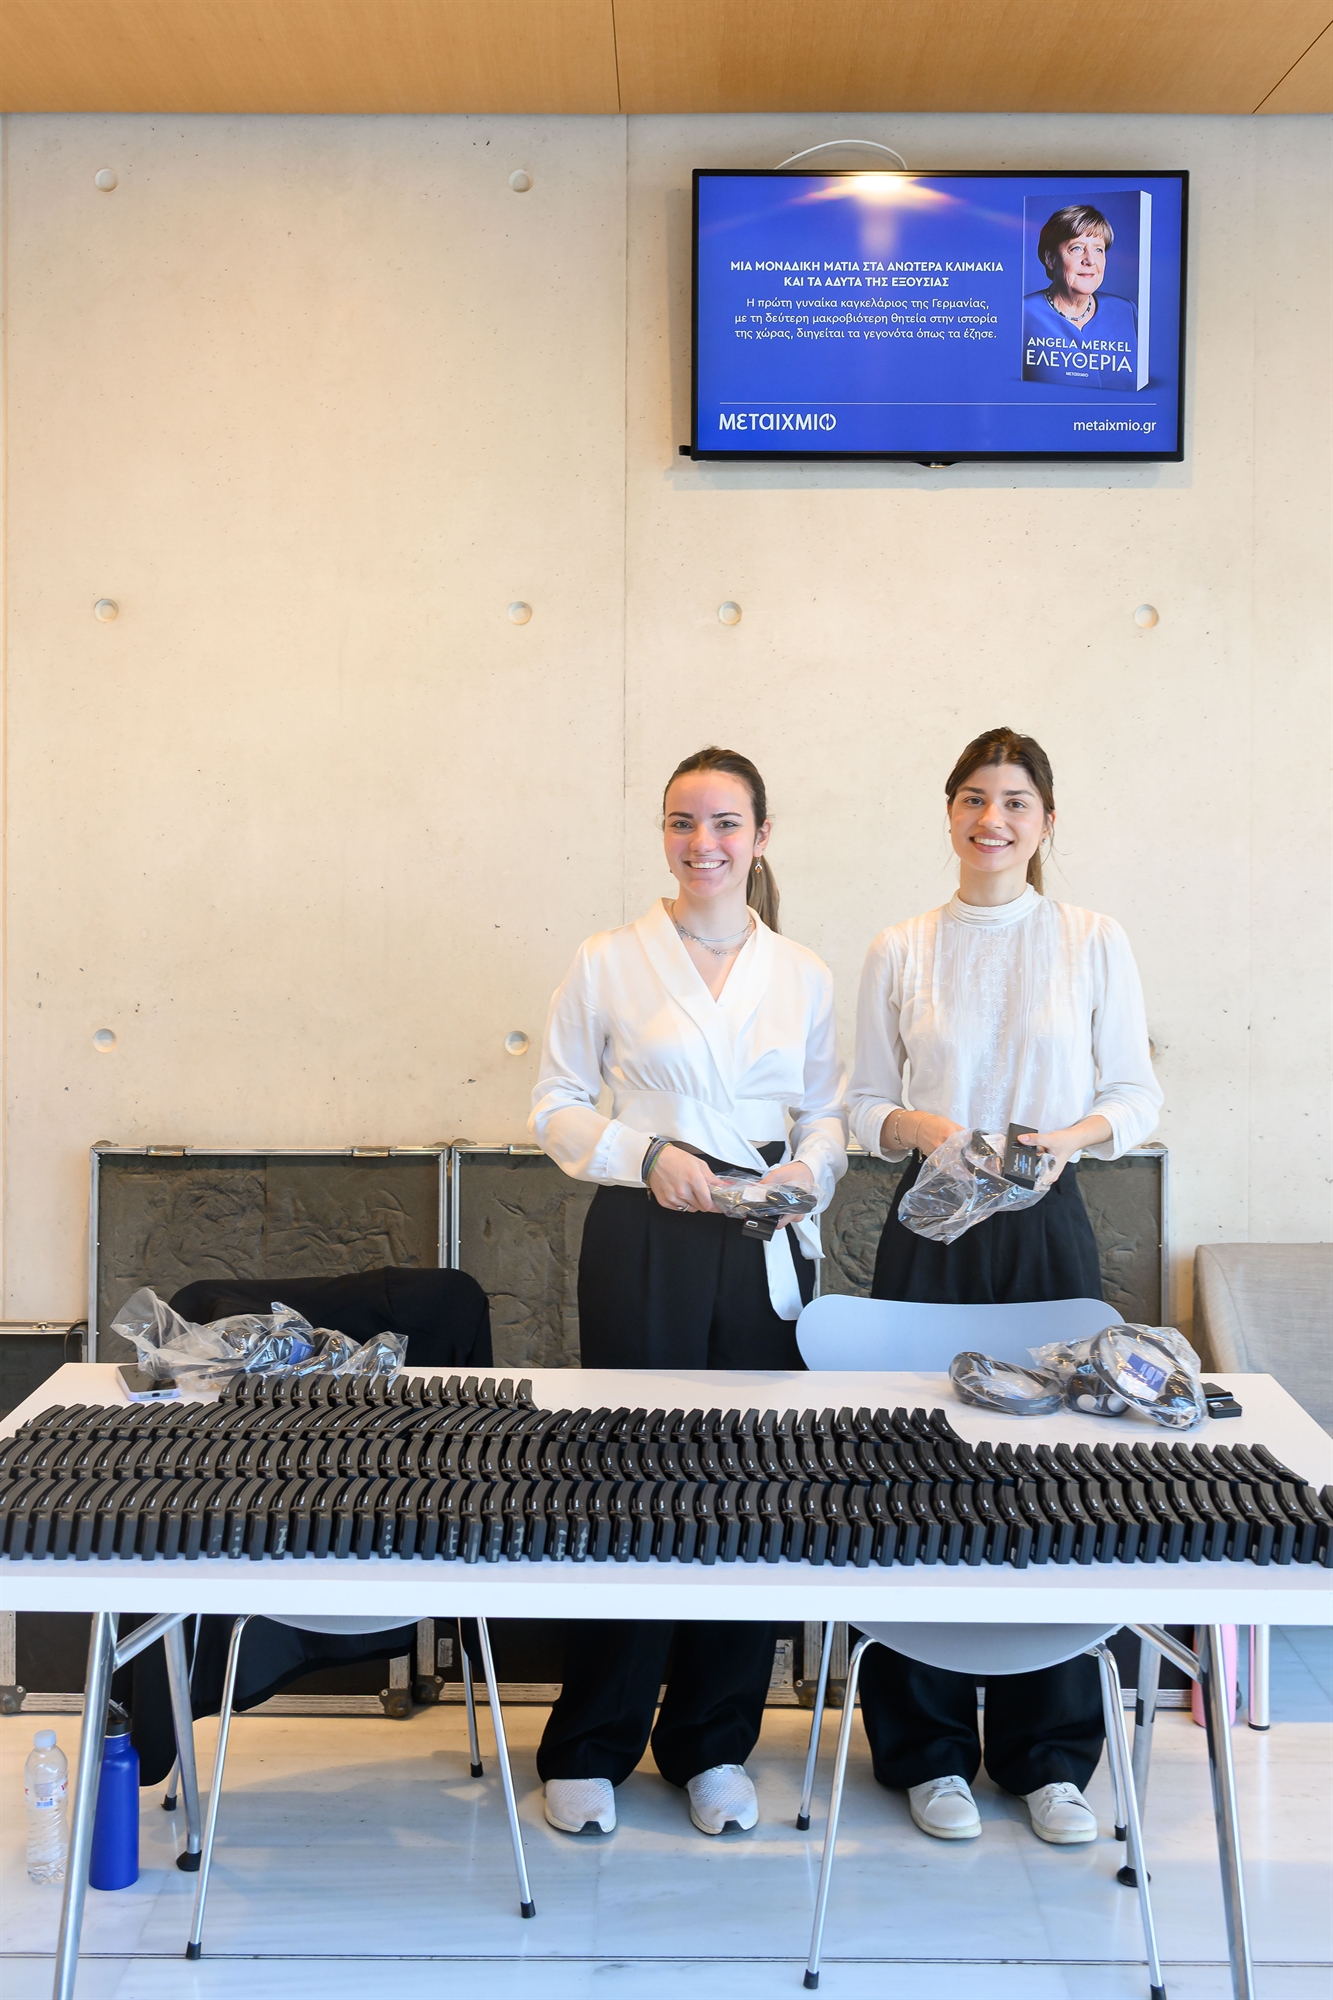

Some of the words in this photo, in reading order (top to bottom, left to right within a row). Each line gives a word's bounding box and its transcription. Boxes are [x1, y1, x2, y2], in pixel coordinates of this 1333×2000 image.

[731, 261, 752, 271] ΜΙΑ
[756, 261, 820, 272] ΜΟΝΑΔΙΚΗ
[824, 262, 859, 272] ΜΑΤΙΑ
[863, 262, 884, 272] ΣΤΑ
[887, 262, 942, 272] ΑΝΩΤΕΡΑ
[946, 262, 1003, 272] ΚΛΙΜΑΚΙΑ
[784, 277, 803, 287] ΚΑΙ
[807, 277, 822, 287] ΤΑ
[825, 277, 862, 287] ΑΔΥΤΑ
[865, 277, 888, 287] ΤΗΣ
[892, 277, 949, 287] ΕΞΟΥΣΙΑΣ
[747, 298, 754, 308] Η
[758, 297, 792, 310] πρώτη
[796, 297, 837, 310] γυναίκα
[841, 298, 907, 310] καγκελάριος
[911, 301, 928, 310] της
[932, 298, 989, 310] Γερμανίας,
[735, 316, 747, 325] με
[750, 316, 762, 325] τη
[766, 313, 809, 325] δεύτερη
[813, 313, 887, 325] μακροβιότερη
[891, 313, 926, 325] θητεία
[930, 316, 954, 326] στην
[958, 313, 997, 326] ιστορία
[735, 331, 752, 340] της
[756, 328, 793, 340] χώρας,
[797, 328, 844, 340] διηγείται
[848, 331, 860, 339] τα
[864, 328, 913, 340] γεγονότα
[917, 328, 945, 341] όπως
[948, 331, 960, 339] τα
[964, 328, 996, 341] έζησε.
[1027, 337, 1078, 349] ANGELA
[1081, 340, 1132, 353] MERKEL
[1026, 349, 1133, 373] ΕΛΕΥΘΕΡΙΑ
[1074, 419, 1156, 434] metaixmio.gr
